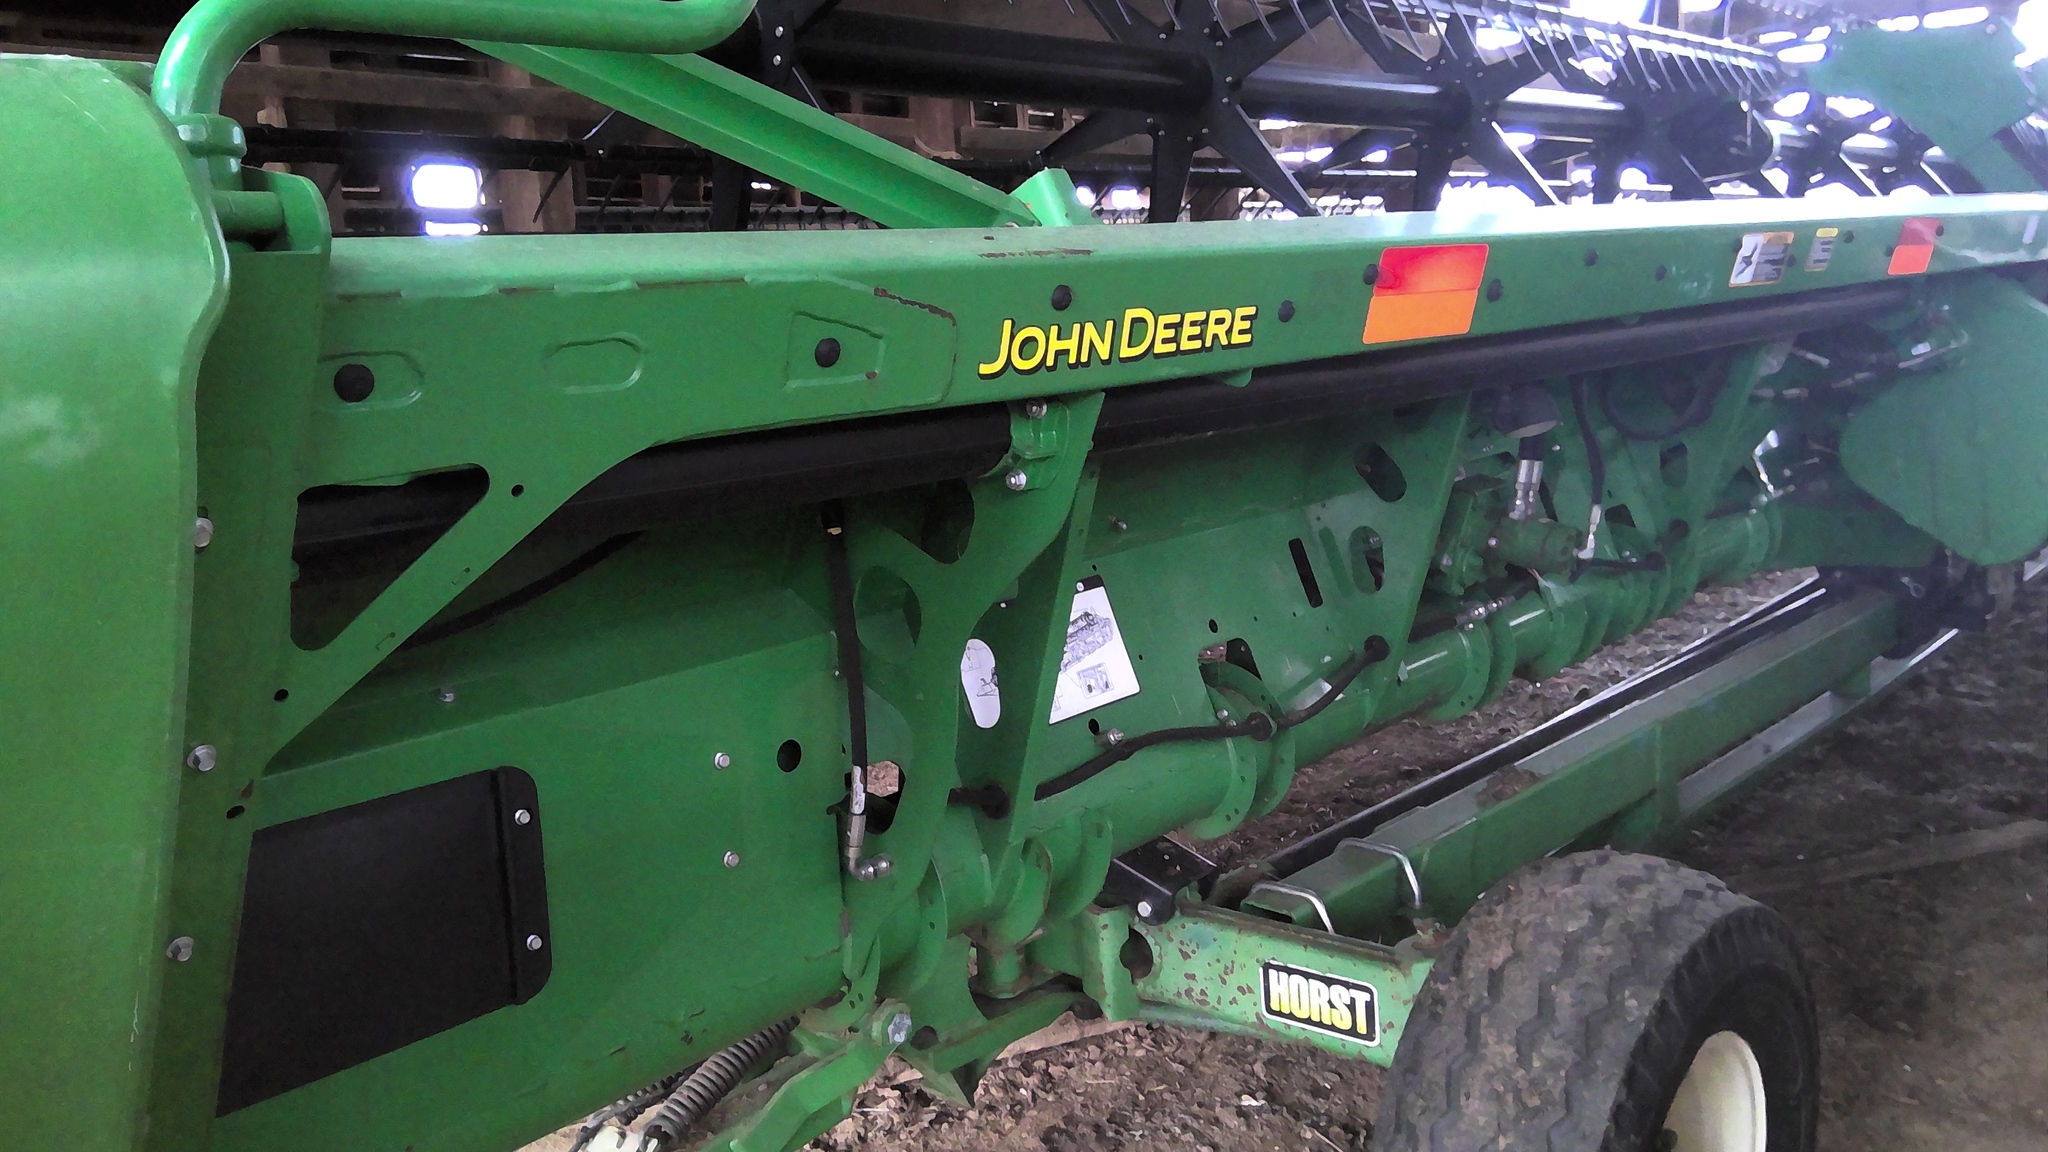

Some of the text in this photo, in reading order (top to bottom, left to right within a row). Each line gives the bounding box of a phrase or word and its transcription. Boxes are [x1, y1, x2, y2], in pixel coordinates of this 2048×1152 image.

[978, 306, 1257, 379] JOHN DEERE
[1268, 968, 1371, 1035] HORST
